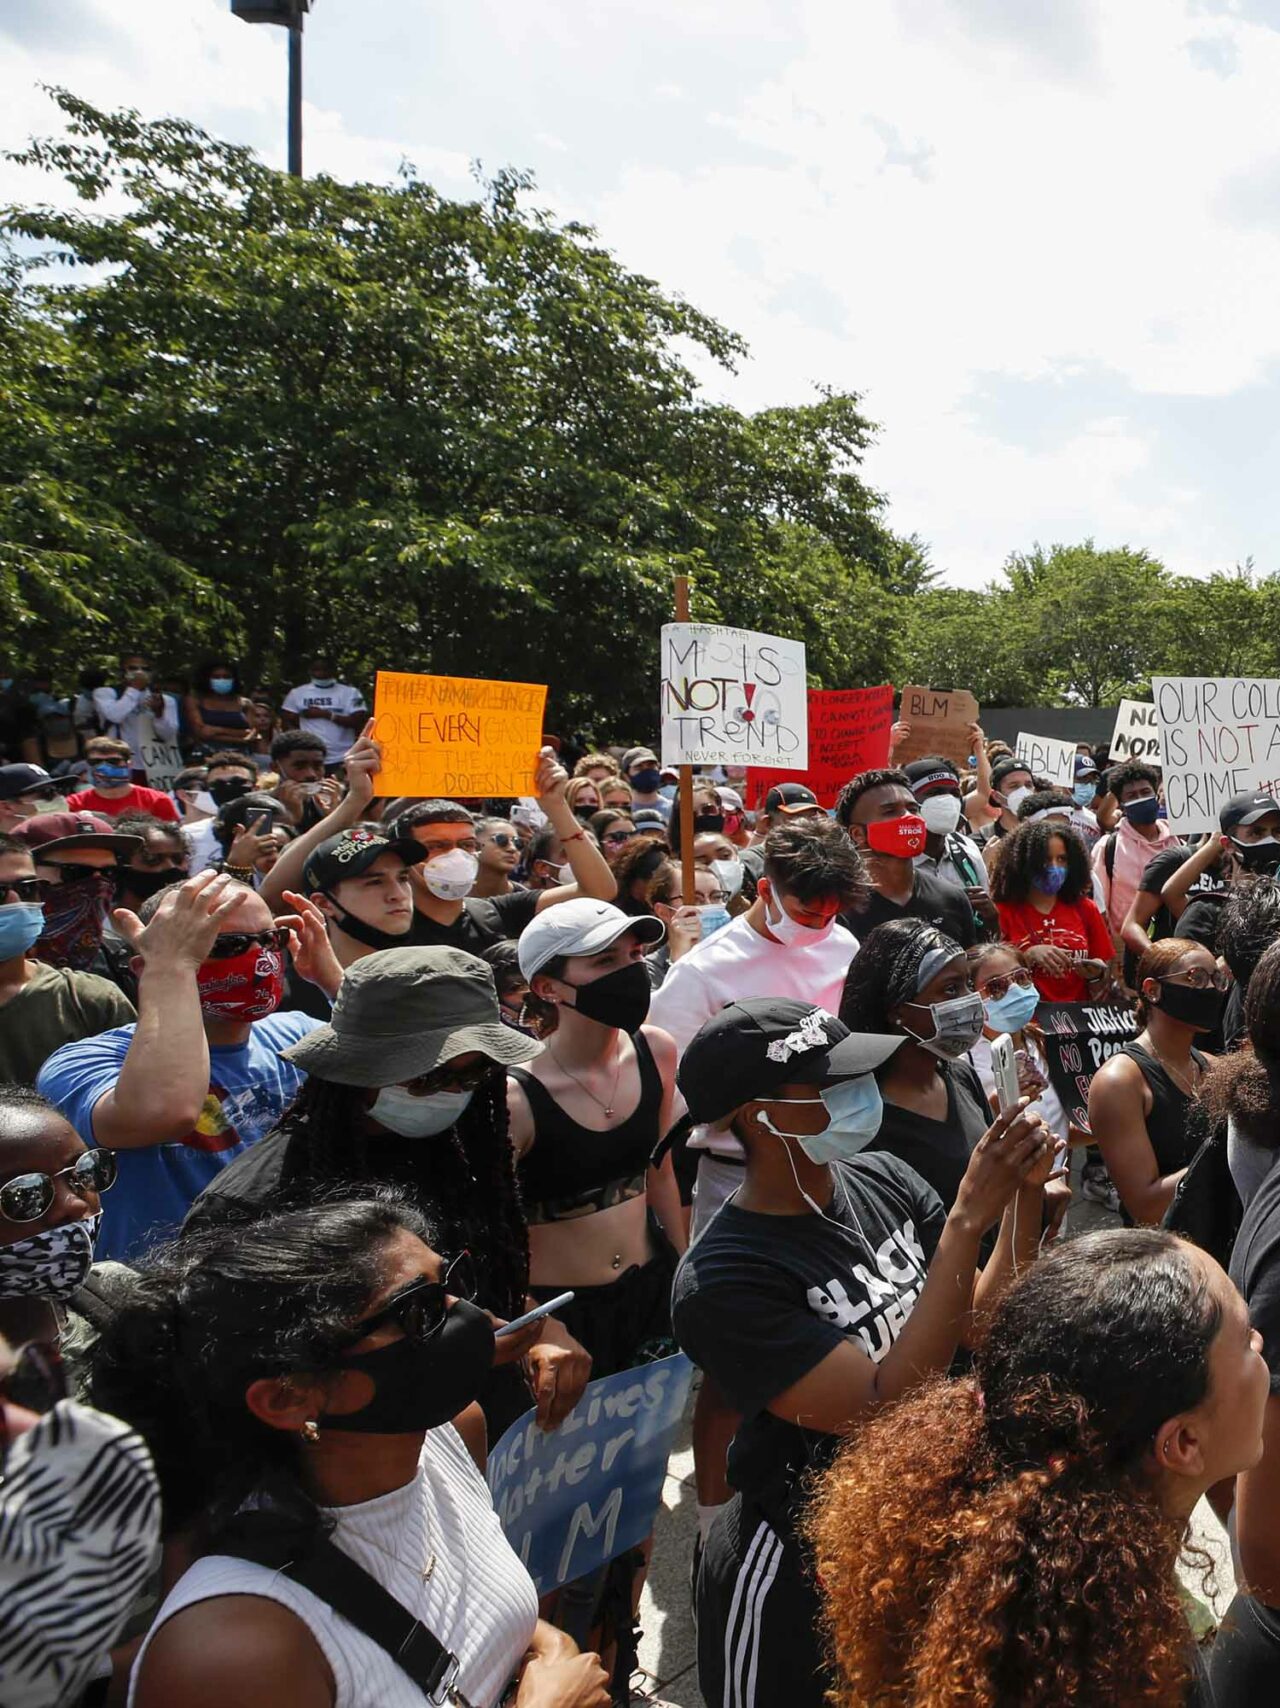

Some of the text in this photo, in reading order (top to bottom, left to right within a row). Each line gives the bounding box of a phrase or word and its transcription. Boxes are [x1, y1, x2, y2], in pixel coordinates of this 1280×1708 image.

[662, 677, 738, 714] NOT
[910, 694, 949, 718] BLM
[1159, 682, 1222, 724] OUR
[373, 712, 415, 745] ON
[417, 712, 481, 747] EVERY
[1164, 728, 1188, 766] IS
[1198, 724, 1260, 765] NOT
[1017, 740, 1074, 779] #BLM
[1167, 768, 1249, 820] CRIME
[1060, 1042, 1083, 1074] NO
[807, 1219, 928, 1328] BLACK
